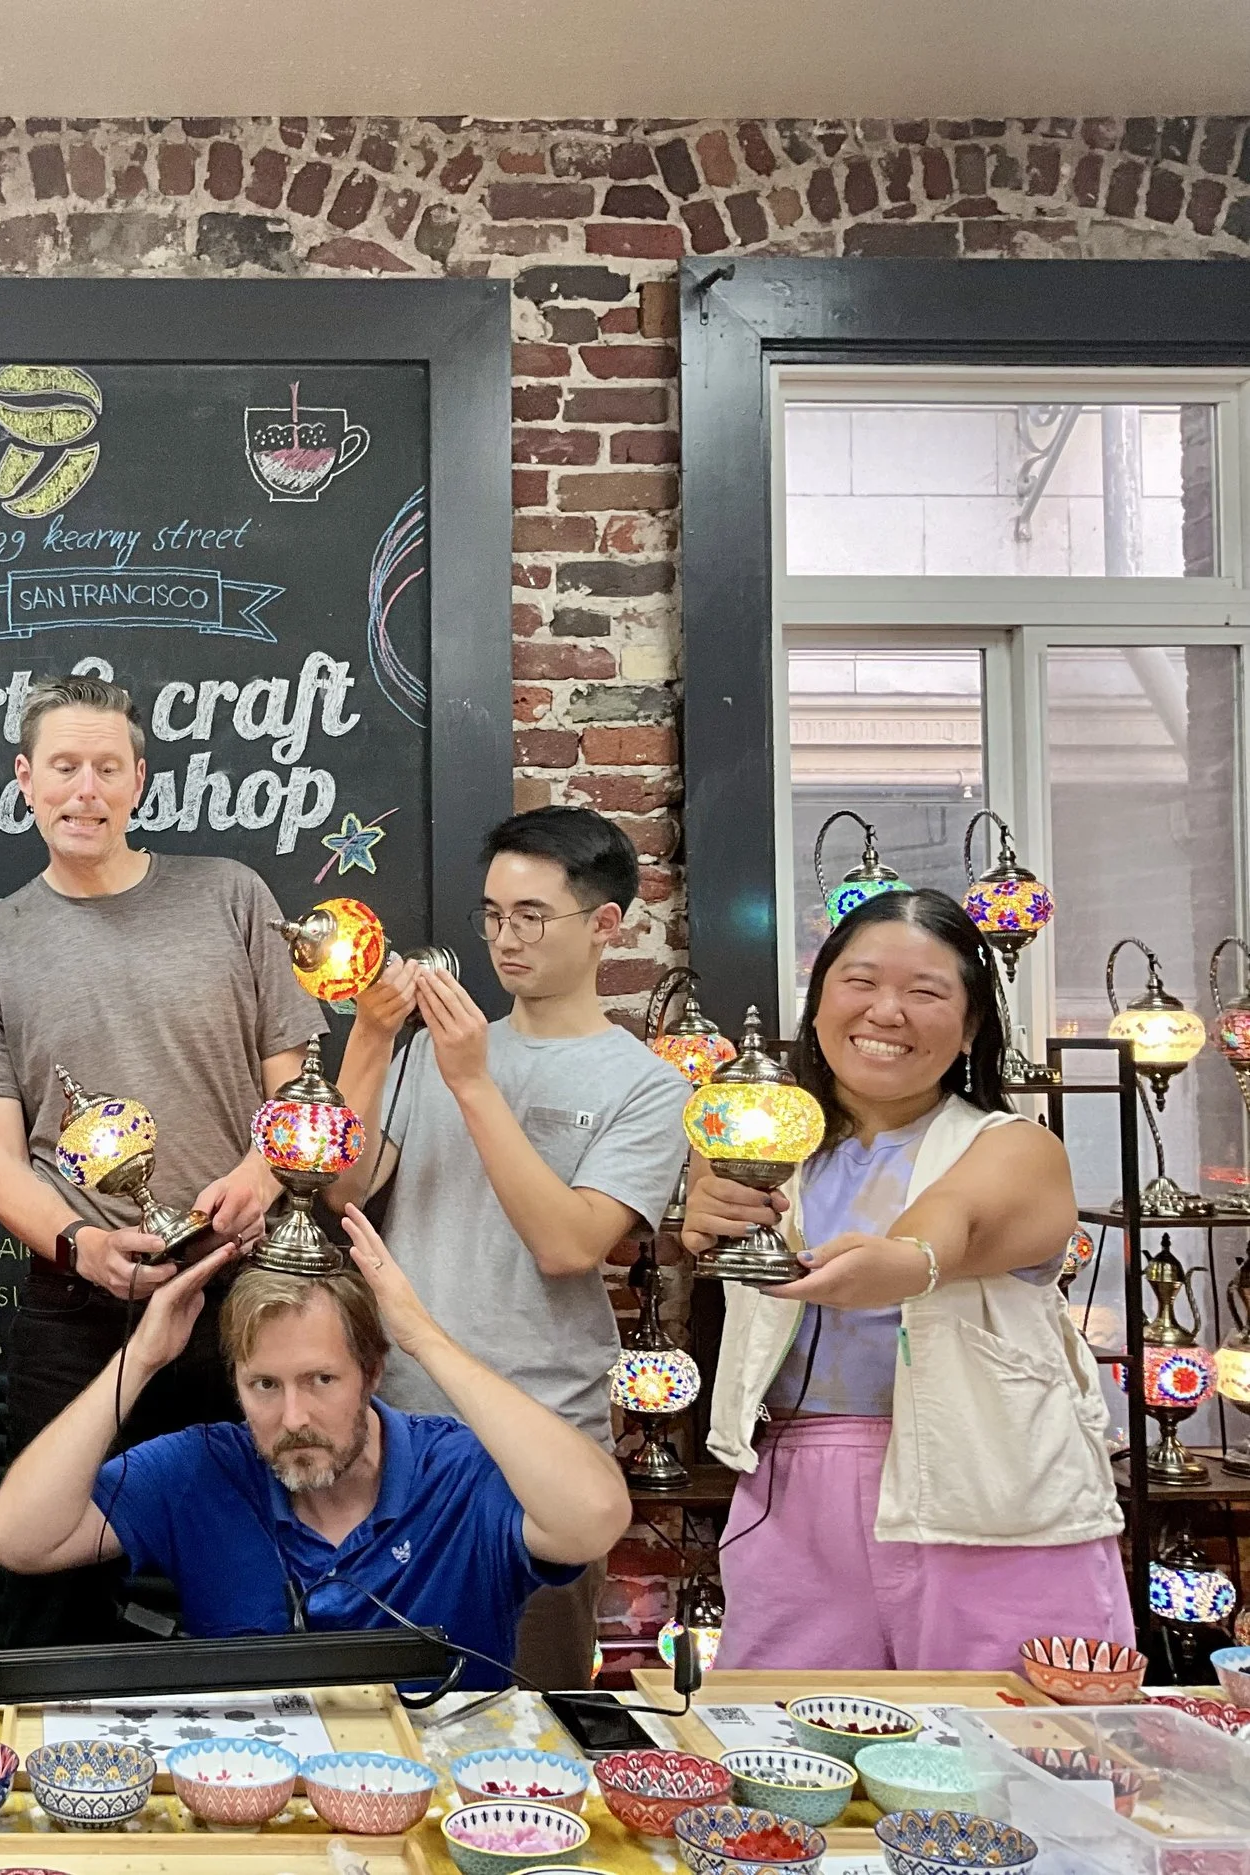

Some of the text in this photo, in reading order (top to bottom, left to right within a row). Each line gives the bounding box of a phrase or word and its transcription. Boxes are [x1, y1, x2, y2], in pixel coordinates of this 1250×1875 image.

[43, 514, 141, 567] kearny
[152, 518, 253, 551] street
[19, 583, 209, 611] SAN FRANCISCO
[152, 651, 361, 765] craft
